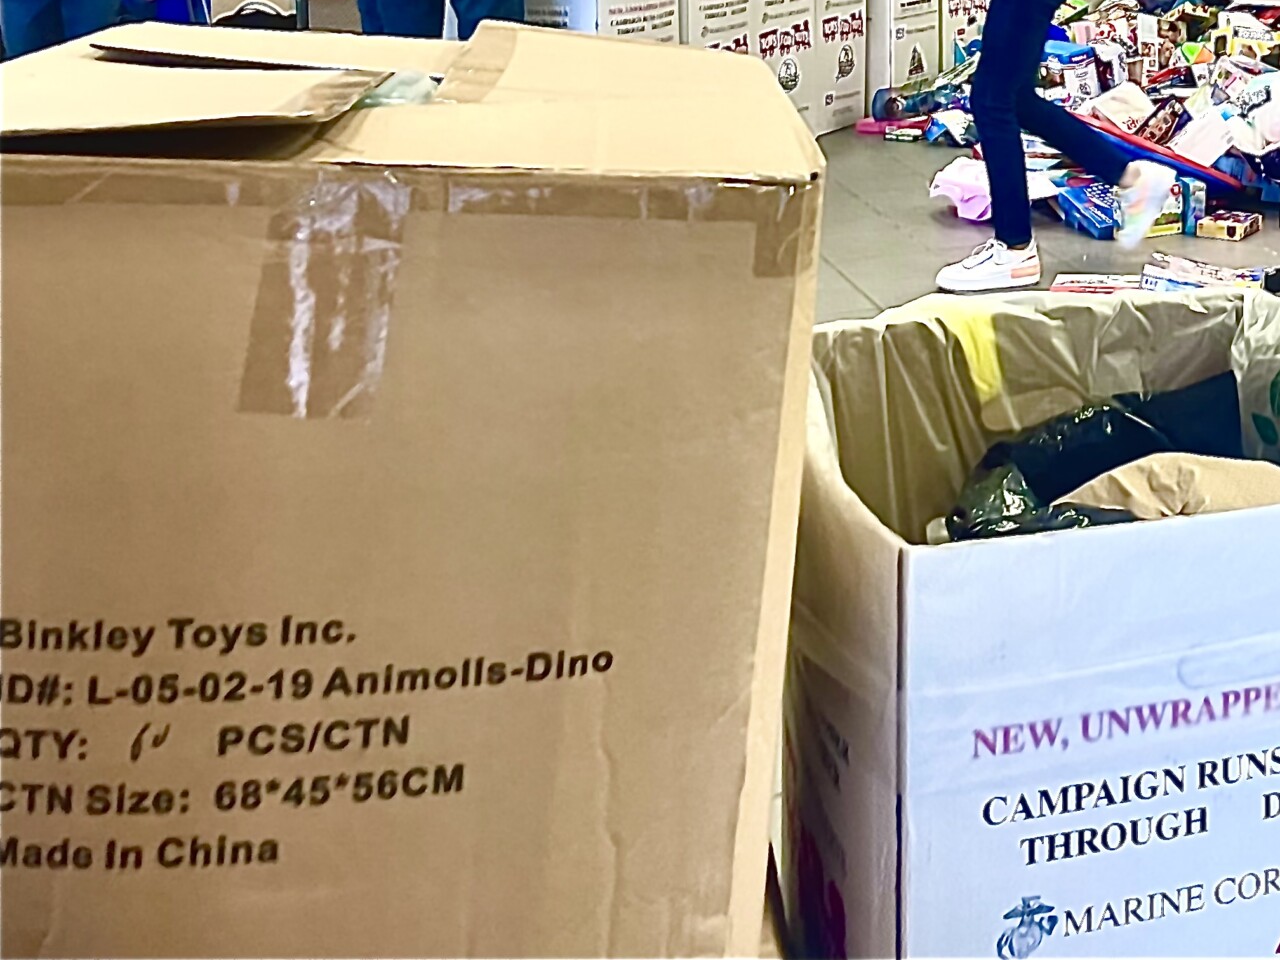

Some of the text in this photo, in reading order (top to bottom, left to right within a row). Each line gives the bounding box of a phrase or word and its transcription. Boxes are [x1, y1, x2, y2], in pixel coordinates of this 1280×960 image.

[0, 615, 356, 657] Binkley Toys Inc.
[87, 668, 314, 706] L-05-02-19
[322, 650, 614, 699] Animolls-Dino
[217, 715, 410, 757] PCS/CTN
[972, 717, 1069, 760] NEW,
[87, 783, 190, 816] Size:
[981, 765, 1186, 827] CAMPAIGN
[105, 839, 143, 870] In
[157, 835, 279, 869] China
[1020, 806, 1209, 866] THROUGH
[1063, 883, 1206, 938] MARINE
